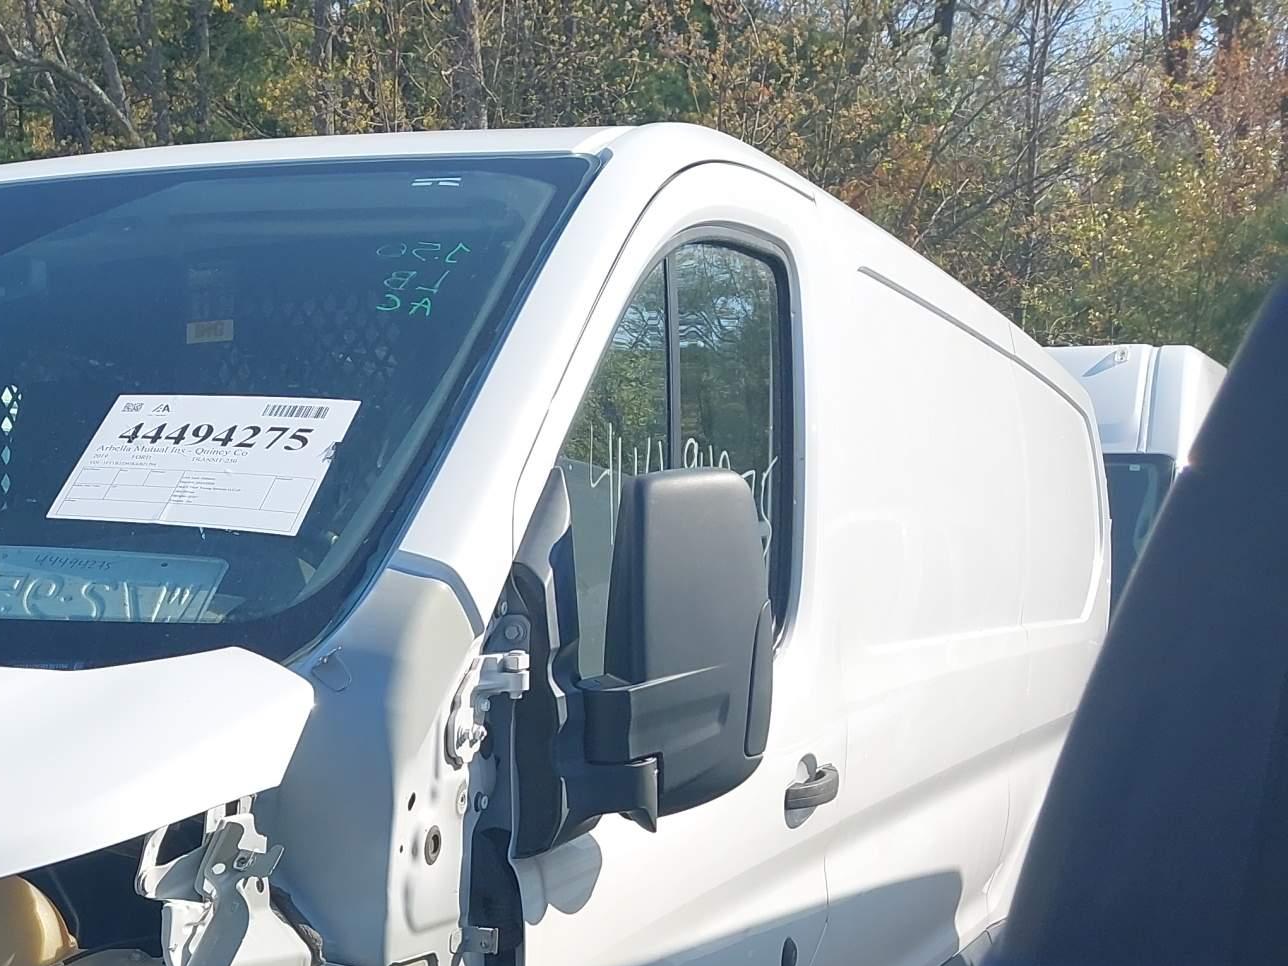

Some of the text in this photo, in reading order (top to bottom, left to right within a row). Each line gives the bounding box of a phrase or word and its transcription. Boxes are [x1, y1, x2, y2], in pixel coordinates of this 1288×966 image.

[118, 421, 314, 451] 44494275
[133, 445, 169, 455] Mutual
[195, 447, 230, 457] Quincy
[233, 448, 249, 457] Co
